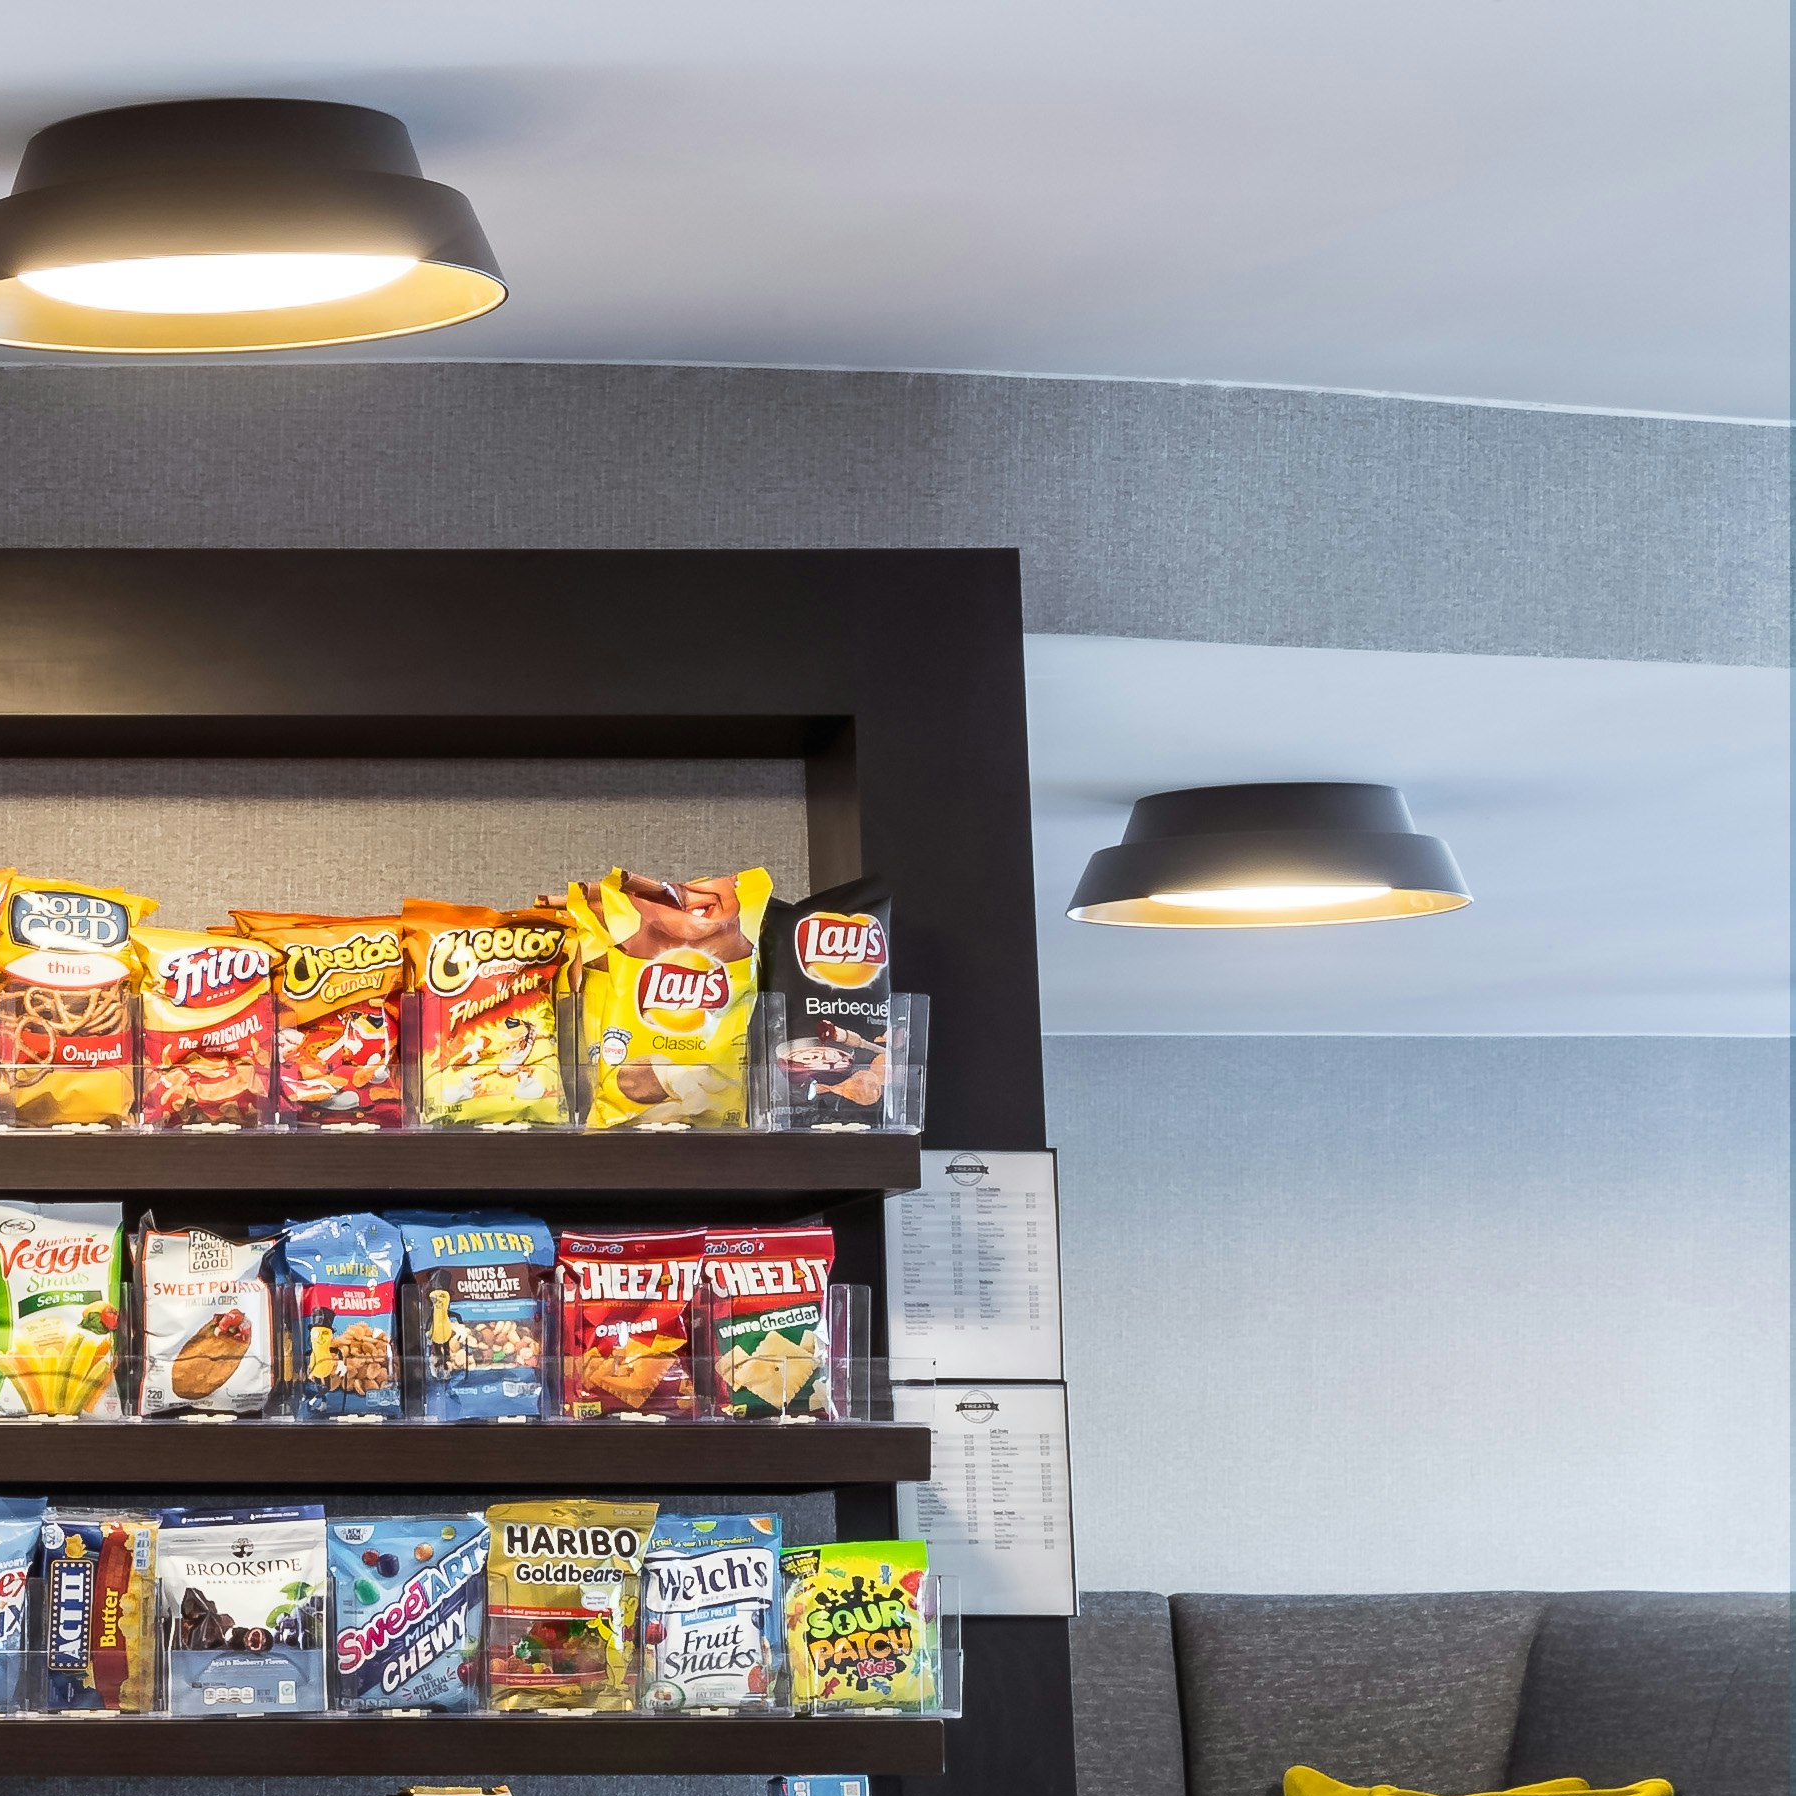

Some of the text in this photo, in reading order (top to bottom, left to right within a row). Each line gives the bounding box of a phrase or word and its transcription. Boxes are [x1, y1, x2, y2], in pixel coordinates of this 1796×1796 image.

[30, 890, 114, 917] ROLD
[20, 914, 120, 944] GOLD
[805, 919, 882, 963] Lay's
[47, 961, 91, 976] thins
[286, 933, 400, 993] Cheetos
[430, 927, 564, 990] Cheetos
[158, 947, 271, 1006] Fritos
[321, 972, 383, 1004] Crunchy
[643, 964, 725, 1010] Lay's
[806, 998, 888, 1018] Barbecue
[178, 1014, 263, 1050] The ORIGINAL
[652, 1036, 706, 1051] Classic
[62, 1045, 123, 1067] Original
[35, 1235, 82, 1251] garden
[431, 1232, 534, 1258] PLANTERS
[569, 1243, 623, 1253] Grab Go
[739, 1243, 754, 1254] Go
[192, 1259, 229, 1270] GOOD
[194, 1250, 229, 1260] TASTE
[27, 1274, 89, 1293] Straws
[466, 1267, 507, 1280] NUTS &
[154, 1280, 260, 1296] SWEET POTATO
[343, 1290, 365, 1298] SALTED
[457, 1279, 520, 1292] CHOCOLATE
[37, 1291, 85, 1307] Sea Salt
[330, 1297, 381, 1310] PEANUTS
[761, 1306, 819, 1331] cheddar
[147, 1390, 162, 1399] 220
[506, 1525, 637, 1558] HARIBO
[186, 1558, 302, 1577] BROOKSIDE
[516, 1564, 623, 1583] Goldbears
[649, 1557, 768, 1601] Welch's
[100, 1588, 119, 1647] Butter
[711, 1606, 732, 1616] FRUIT
[810, 1598, 904, 1639] SOUR
[59, 1606, 83, 1659] ACT
[405, 1608, 440, 1647] MINI
[382, 1603, 468, 1692] CHEWY
[683, 1625, 743, 1655] Fruit
[809, 1628, 913, 1670] PATCH
[663, 1646, 756, 1679] Snacks
[857, 1658, 895, 1679] Kids
